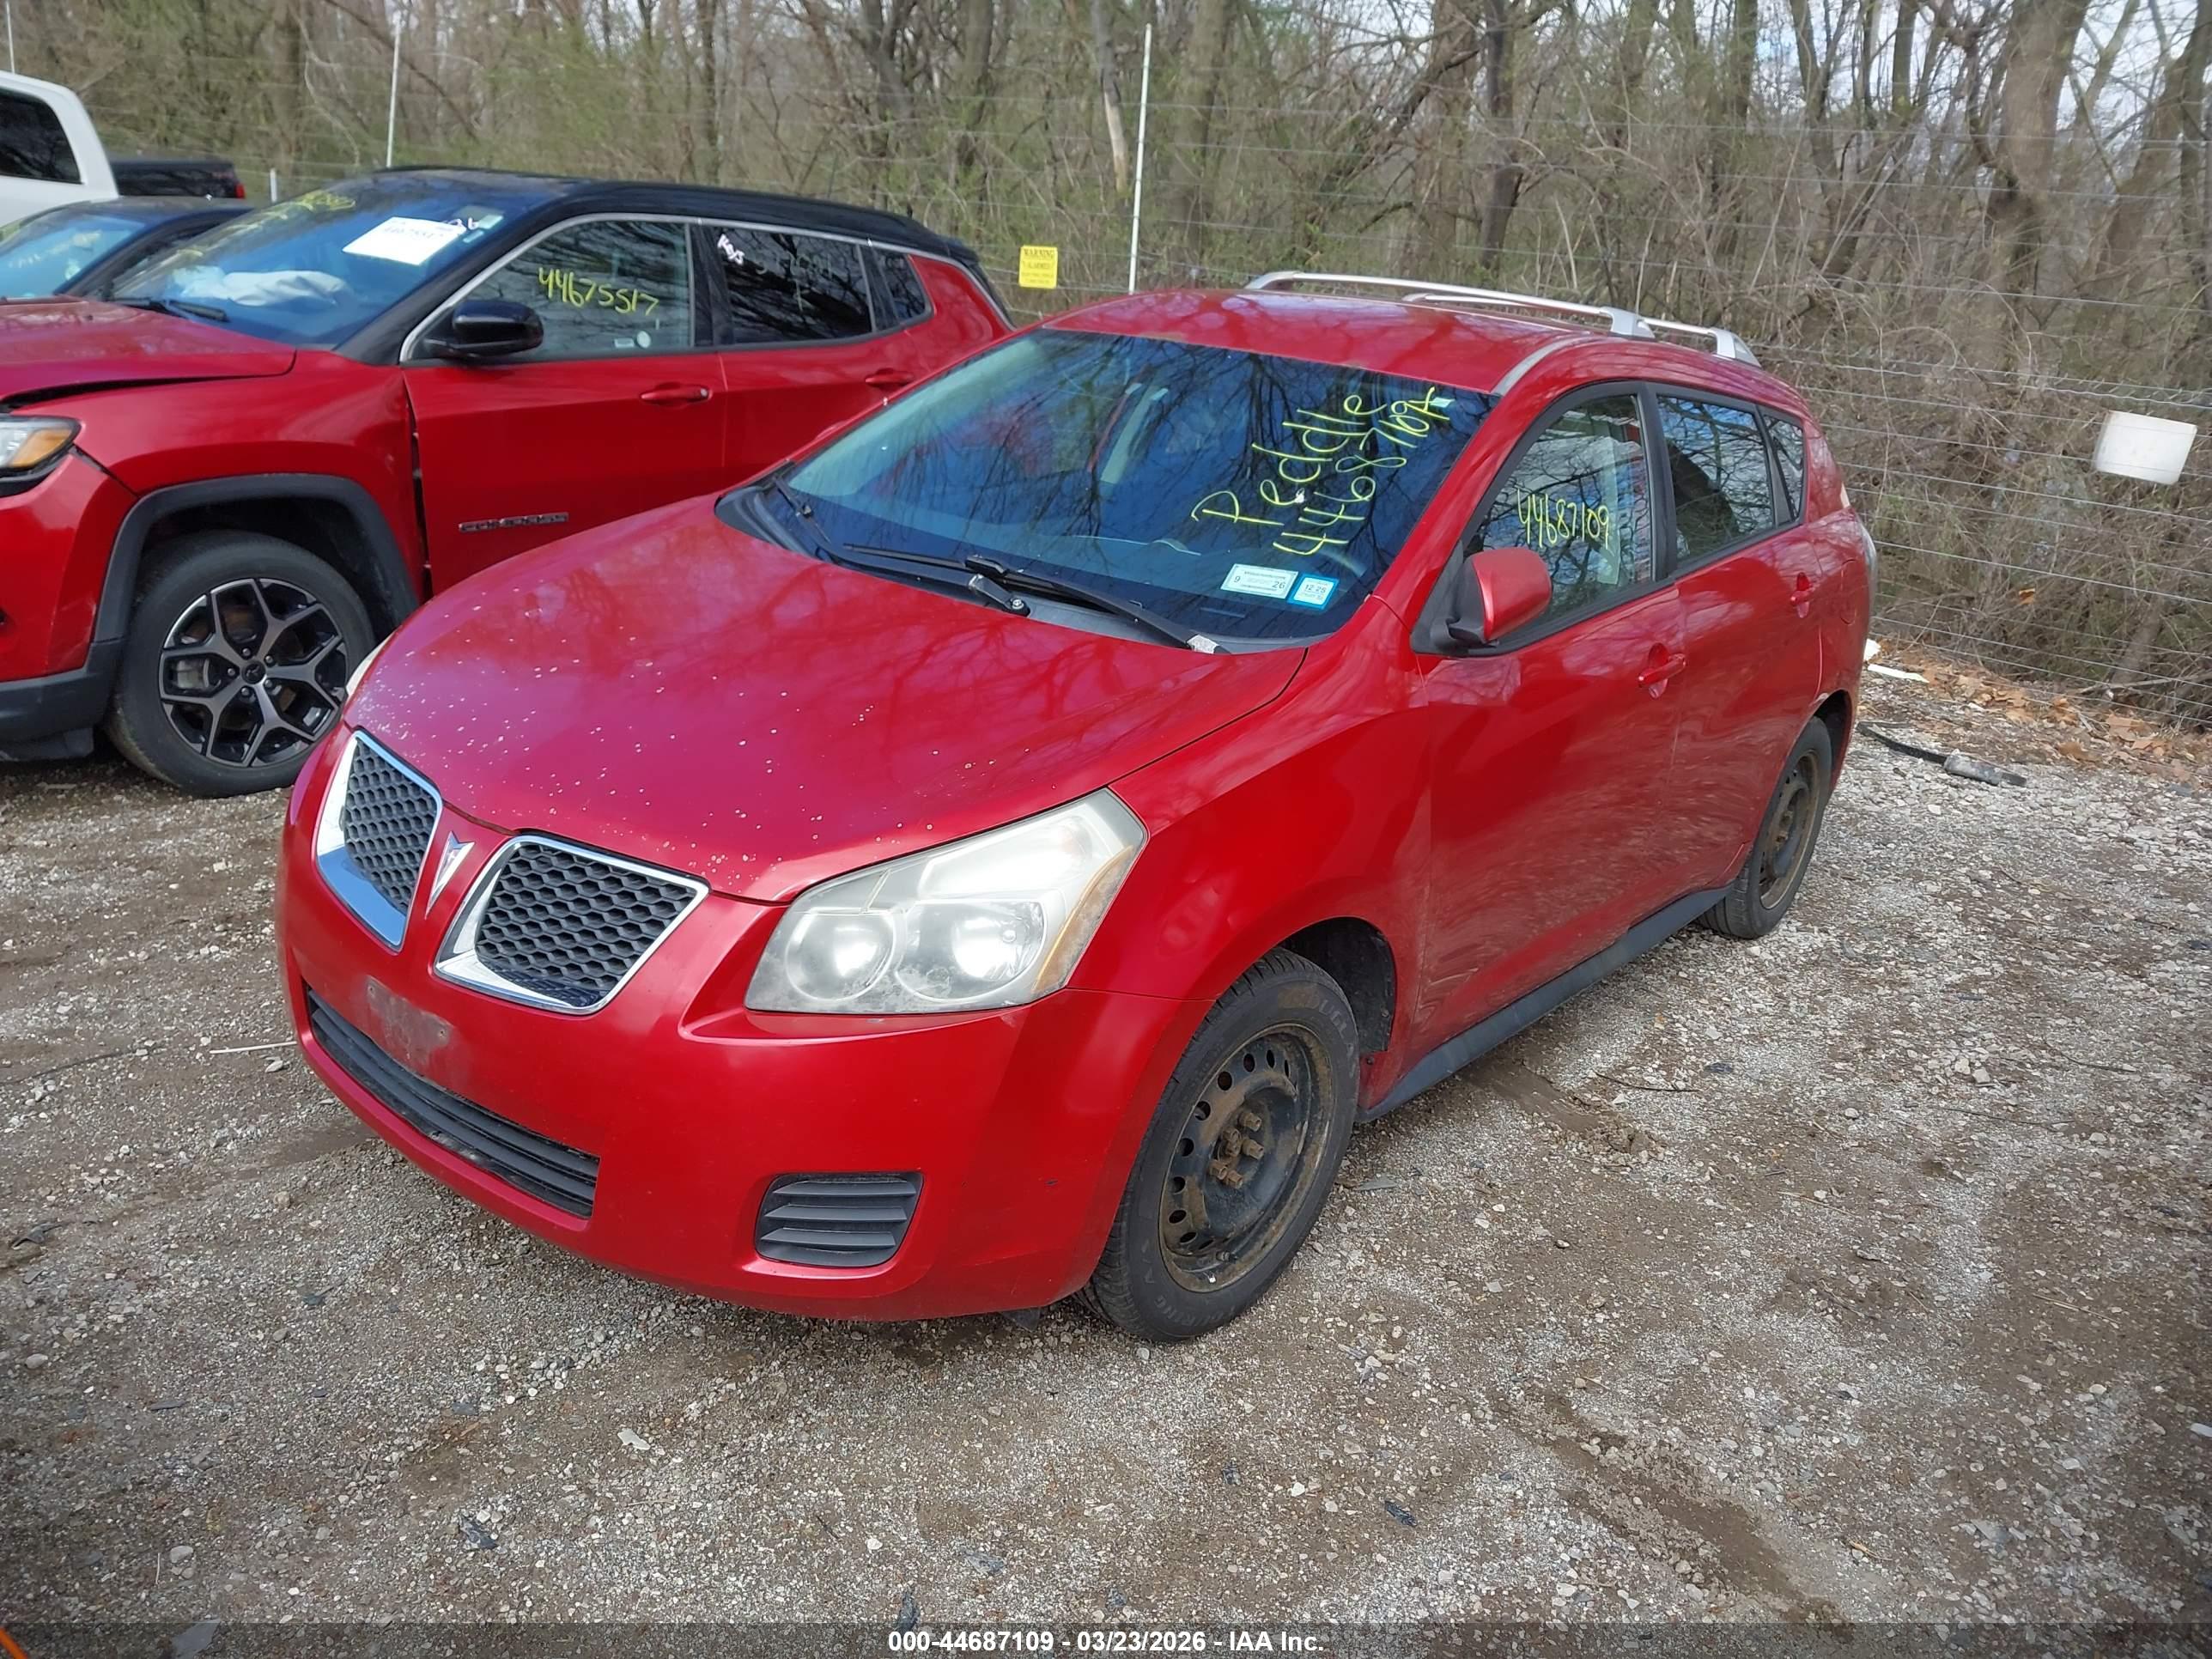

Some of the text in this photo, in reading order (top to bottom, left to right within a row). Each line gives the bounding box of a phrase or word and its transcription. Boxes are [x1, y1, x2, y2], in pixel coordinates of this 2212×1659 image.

[538, 266, 660, 316] 44675517
[1191, 395, 1388, 526] Peddle
[1517, 488, 1609, 550] 44687109
